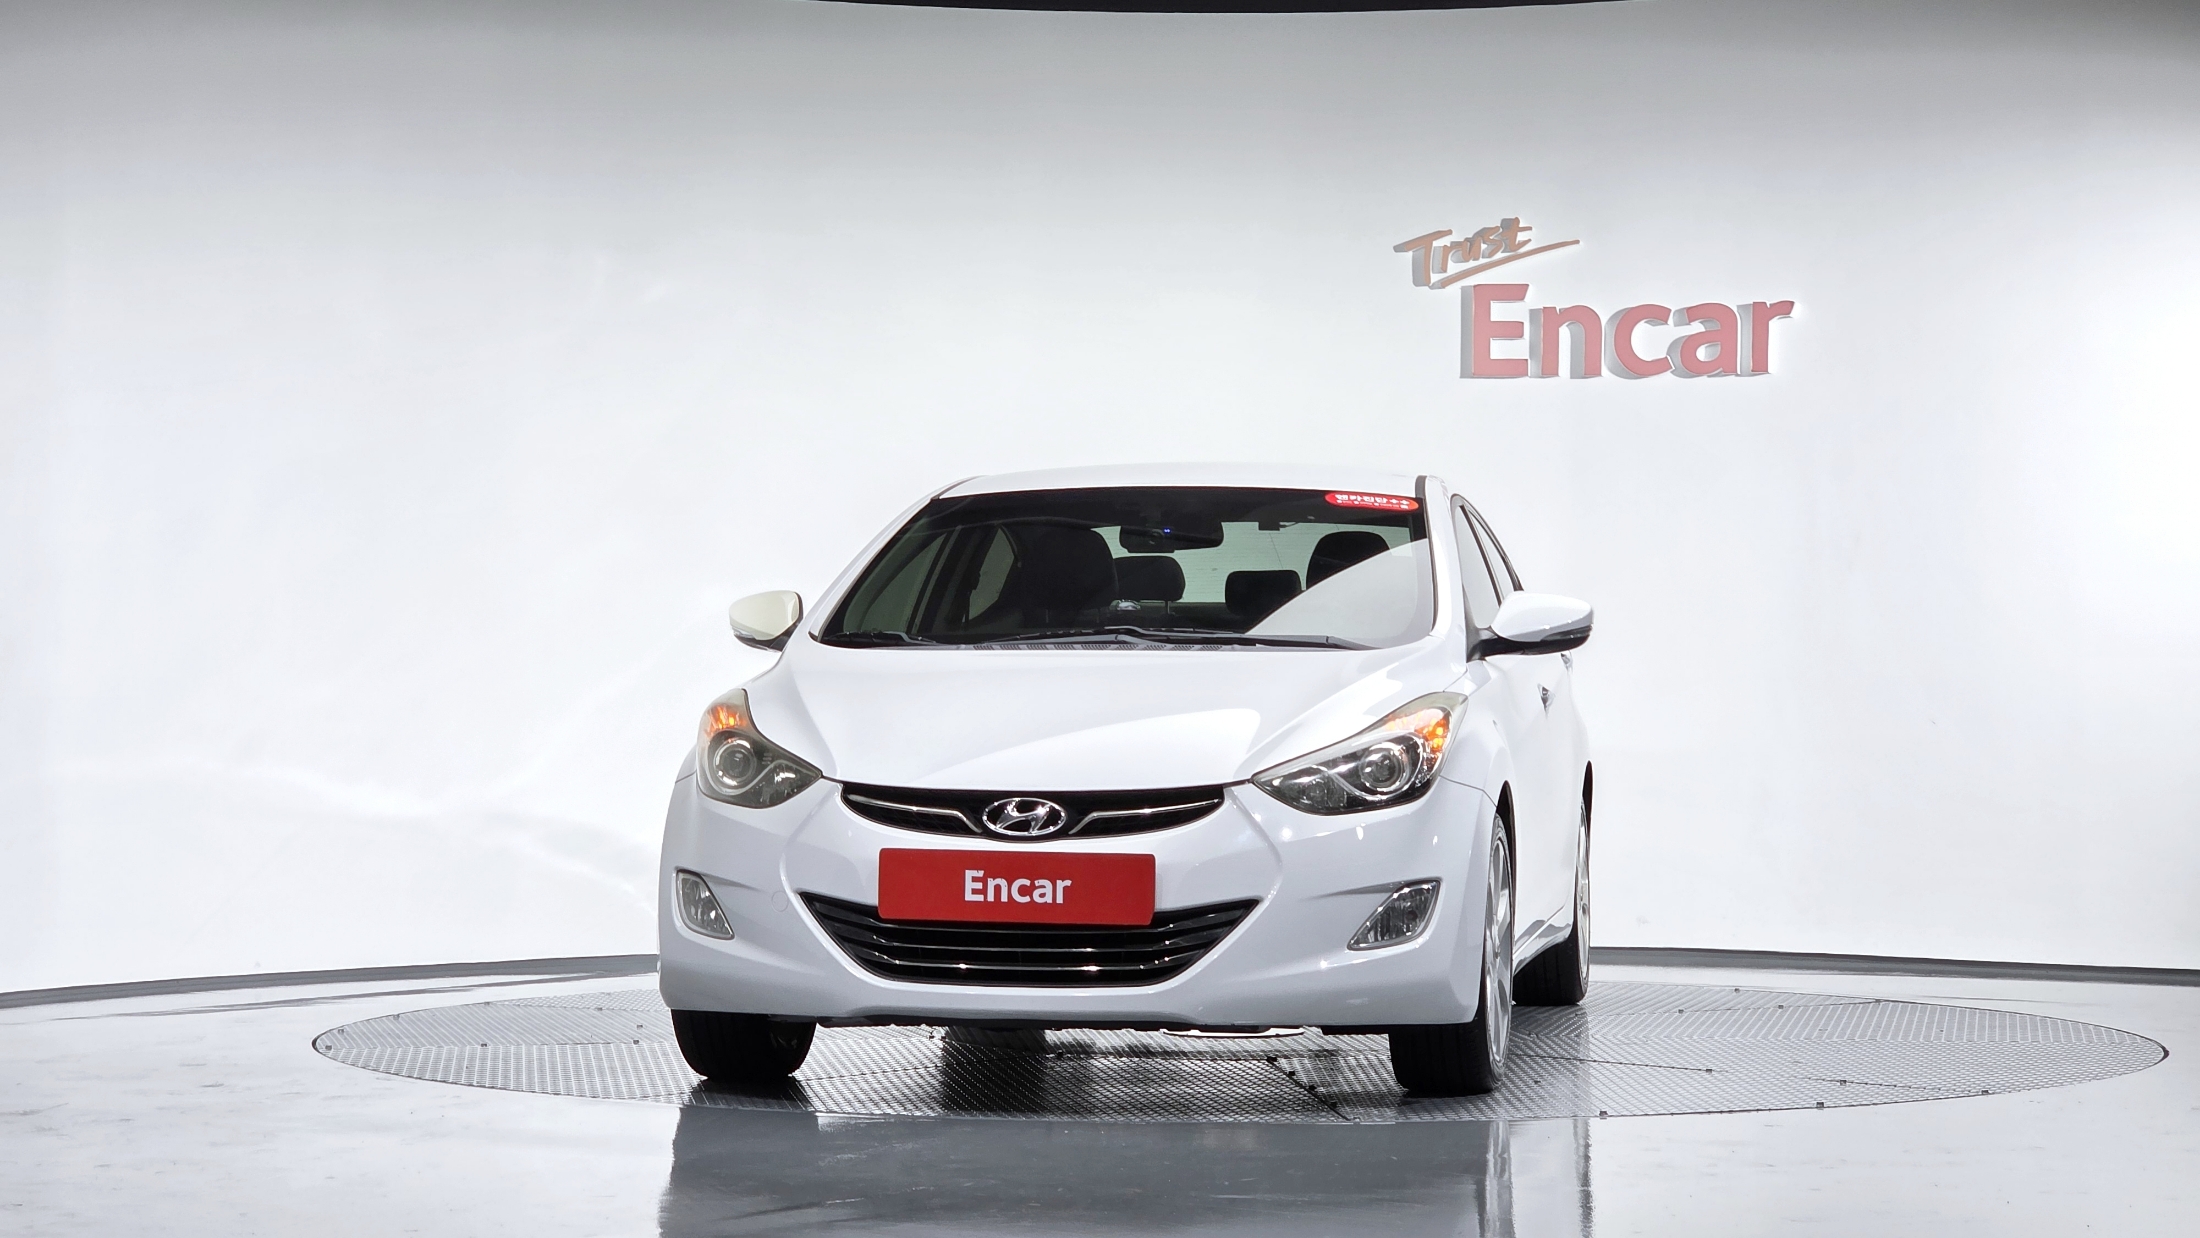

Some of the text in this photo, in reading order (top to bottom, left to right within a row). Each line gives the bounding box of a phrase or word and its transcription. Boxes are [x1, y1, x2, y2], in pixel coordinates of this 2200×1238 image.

[1395, 217, 1534, 287] Trust
[1461, 283, 1796, 379] Encar
[964, 869, 1073, 904] Encar
